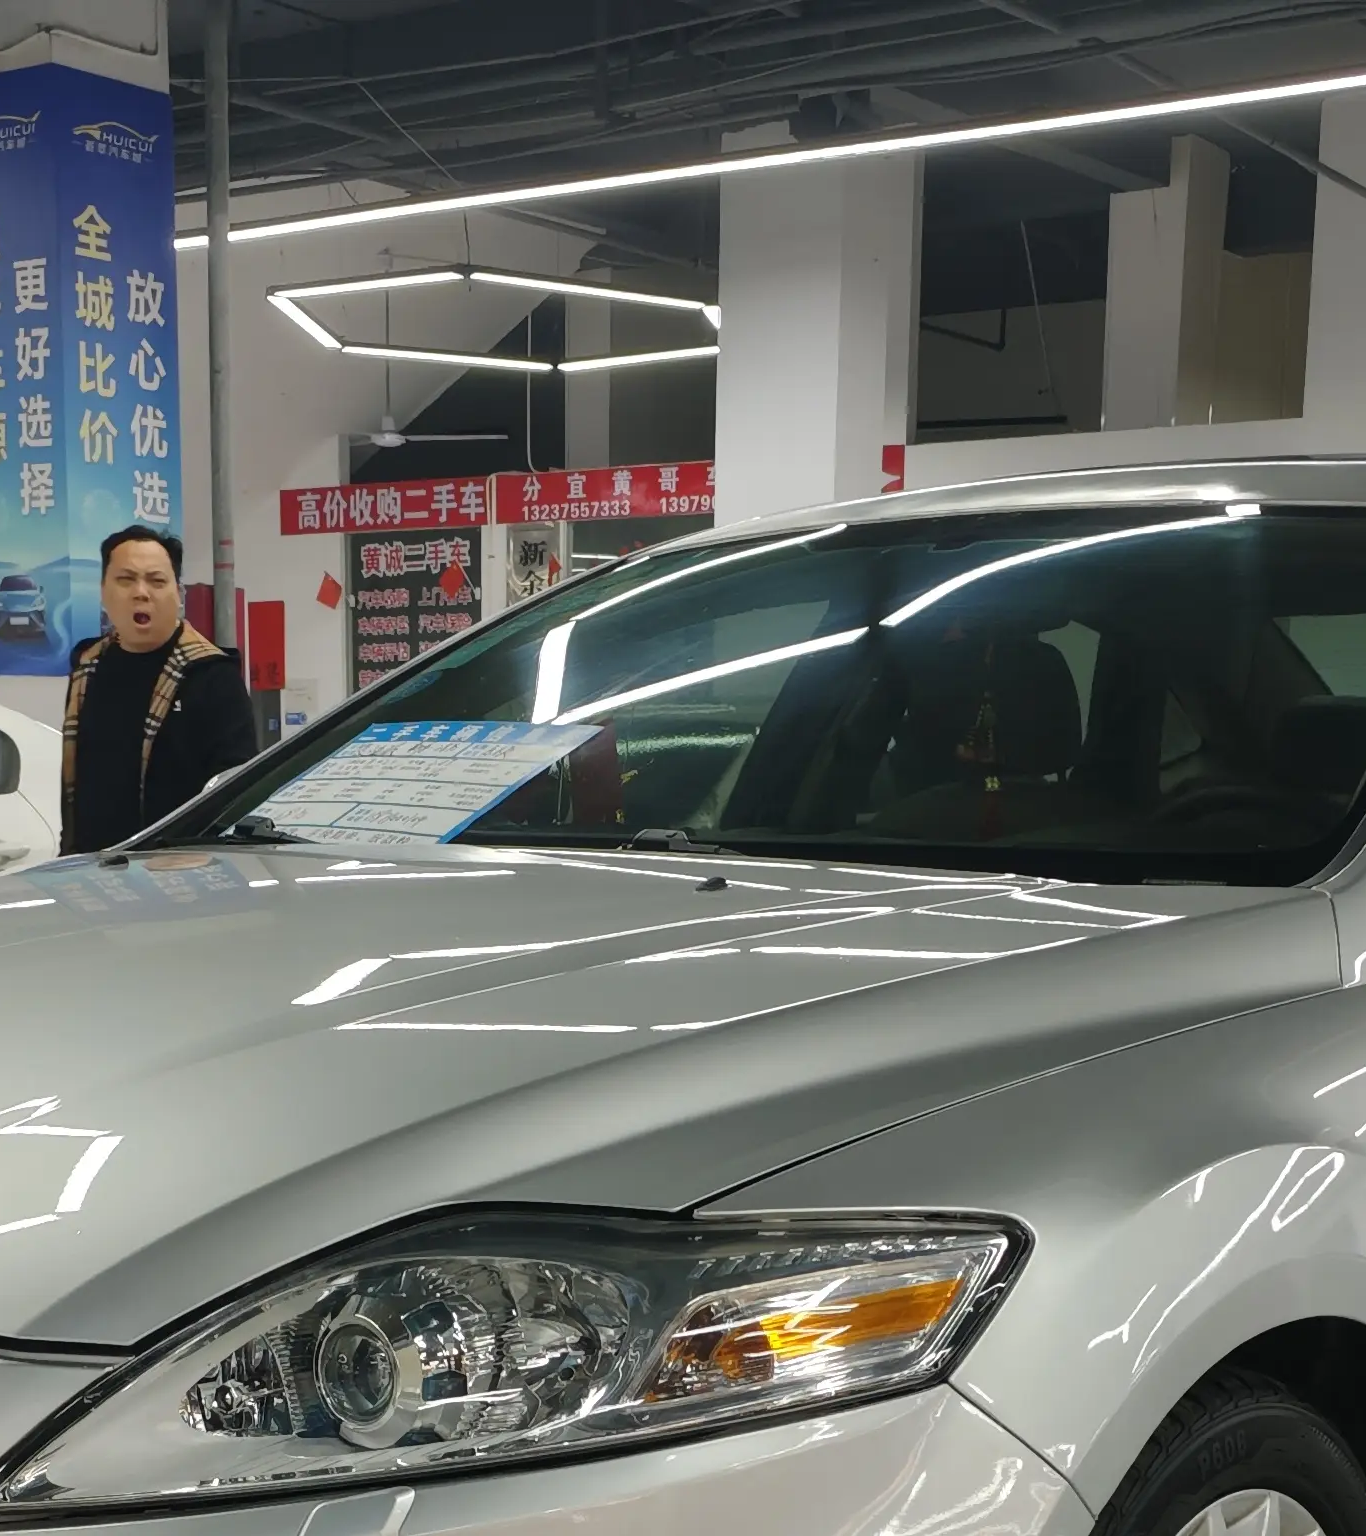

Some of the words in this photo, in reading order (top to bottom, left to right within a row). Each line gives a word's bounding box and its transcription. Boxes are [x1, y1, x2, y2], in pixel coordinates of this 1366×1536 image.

[103, 131, 153, 154] HUICUI
[73, 205, 118, 466] 全城比价
[12, 257, 55, 516] 更好选择
[126, 269, 172, 525] 放心优选
[296, 481, 485, 530] 高价收购二手车
[521, 499, 630, 521] 13237557333
[361, 537, 471, 578] 黄诚二手车
